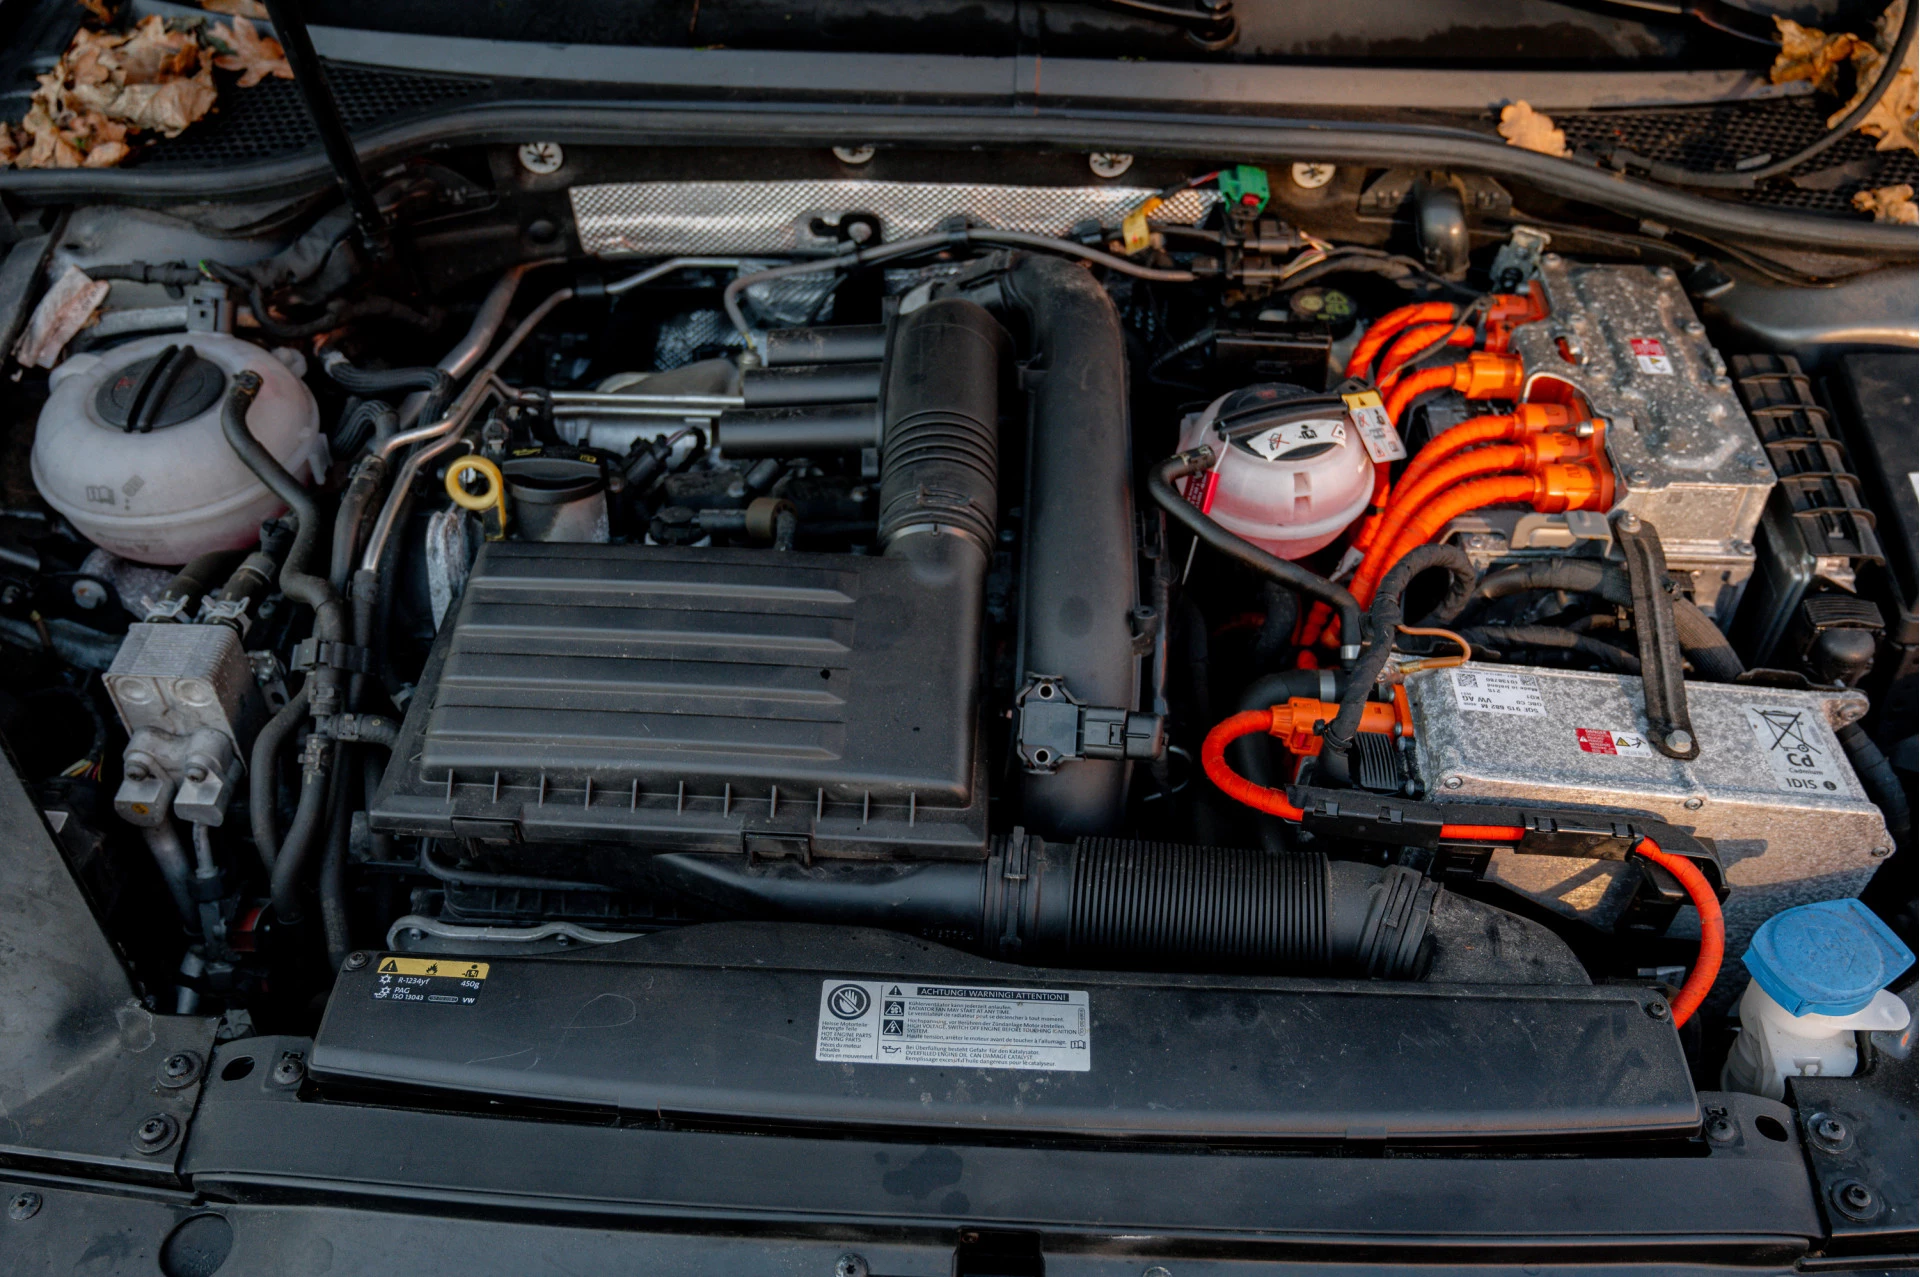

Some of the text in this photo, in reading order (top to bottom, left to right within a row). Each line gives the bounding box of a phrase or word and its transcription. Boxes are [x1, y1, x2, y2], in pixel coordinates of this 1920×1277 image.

[1787, 753, 1815, 767] Cd
[1789, 767, 1823, 775] Cadmium
[1786, 778, 1818, 789] IDIS
[398, 977, 480, 989] R-1234yf 450g
[920, 988, 1066, 1001] ACHTUNG! WARNING! ATTENTION!
